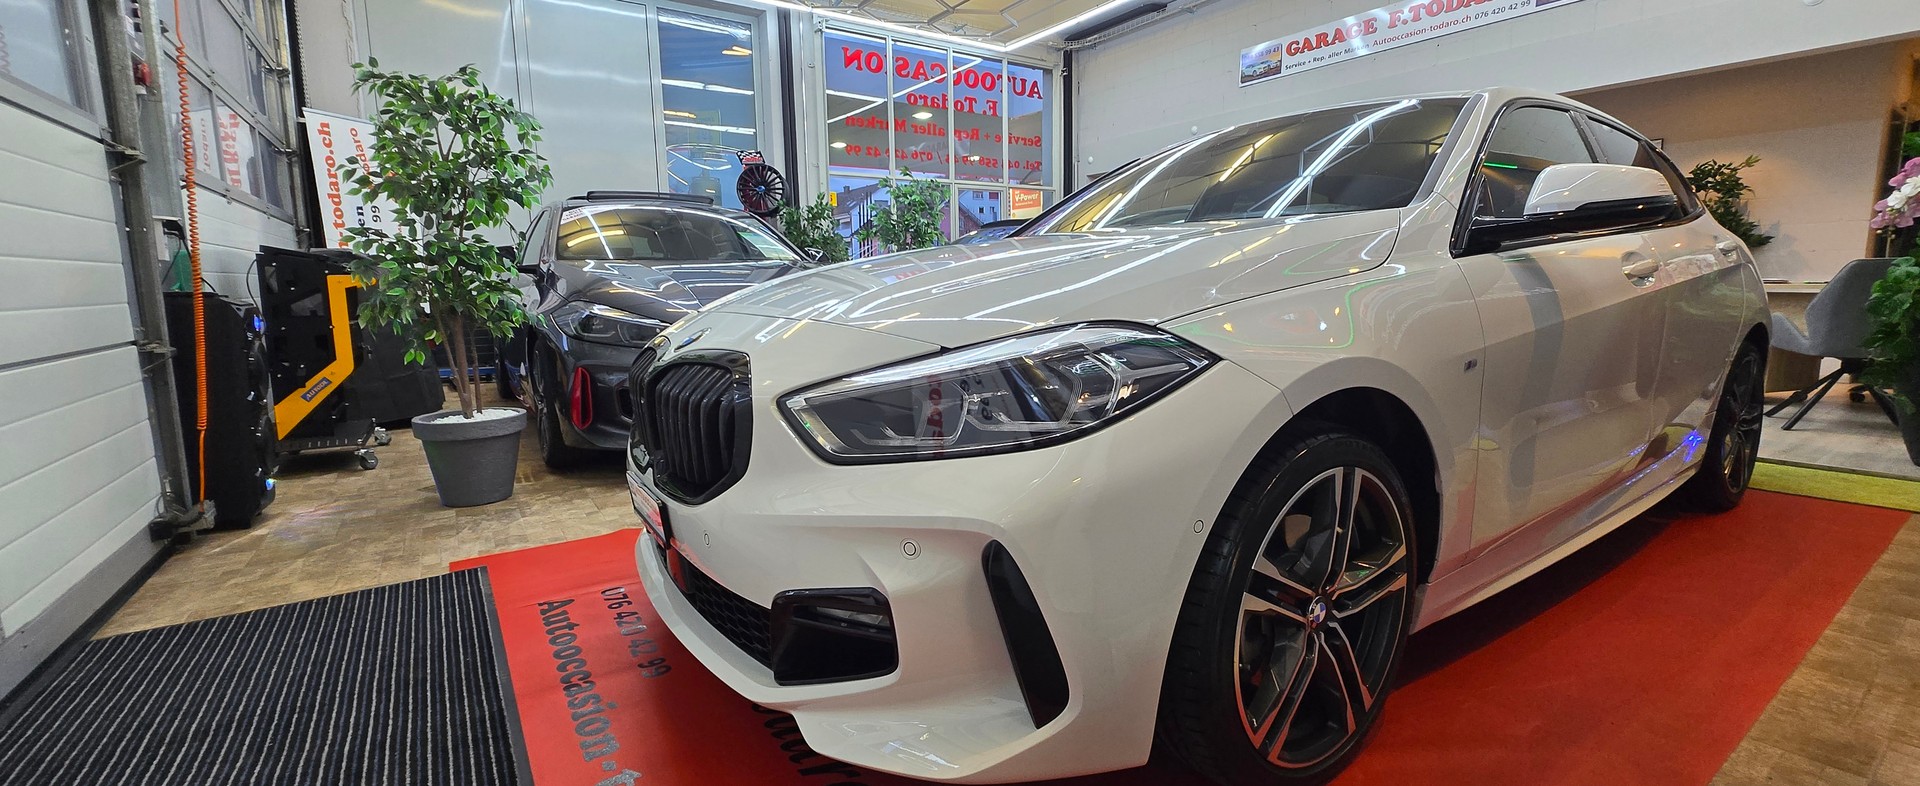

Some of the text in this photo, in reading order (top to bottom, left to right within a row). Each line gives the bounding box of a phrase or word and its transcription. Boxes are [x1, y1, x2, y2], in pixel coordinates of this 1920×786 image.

[1285, 60, 1306, 70] Service
[1328, 51, 1342, 59] aller
[1372, 15, 1472, 47] Autooccasion-todaro.ch
[1474, 10, 1489, 20] 076
[1491, 6, 1506, 16] 420
[1507, 3, 1518, 11] 42
[1520, 0, 1531, 8] 99
[1285, 17, 1378, 57] GARAGE
[601, 586, 672, 679] 076 420 42 99
